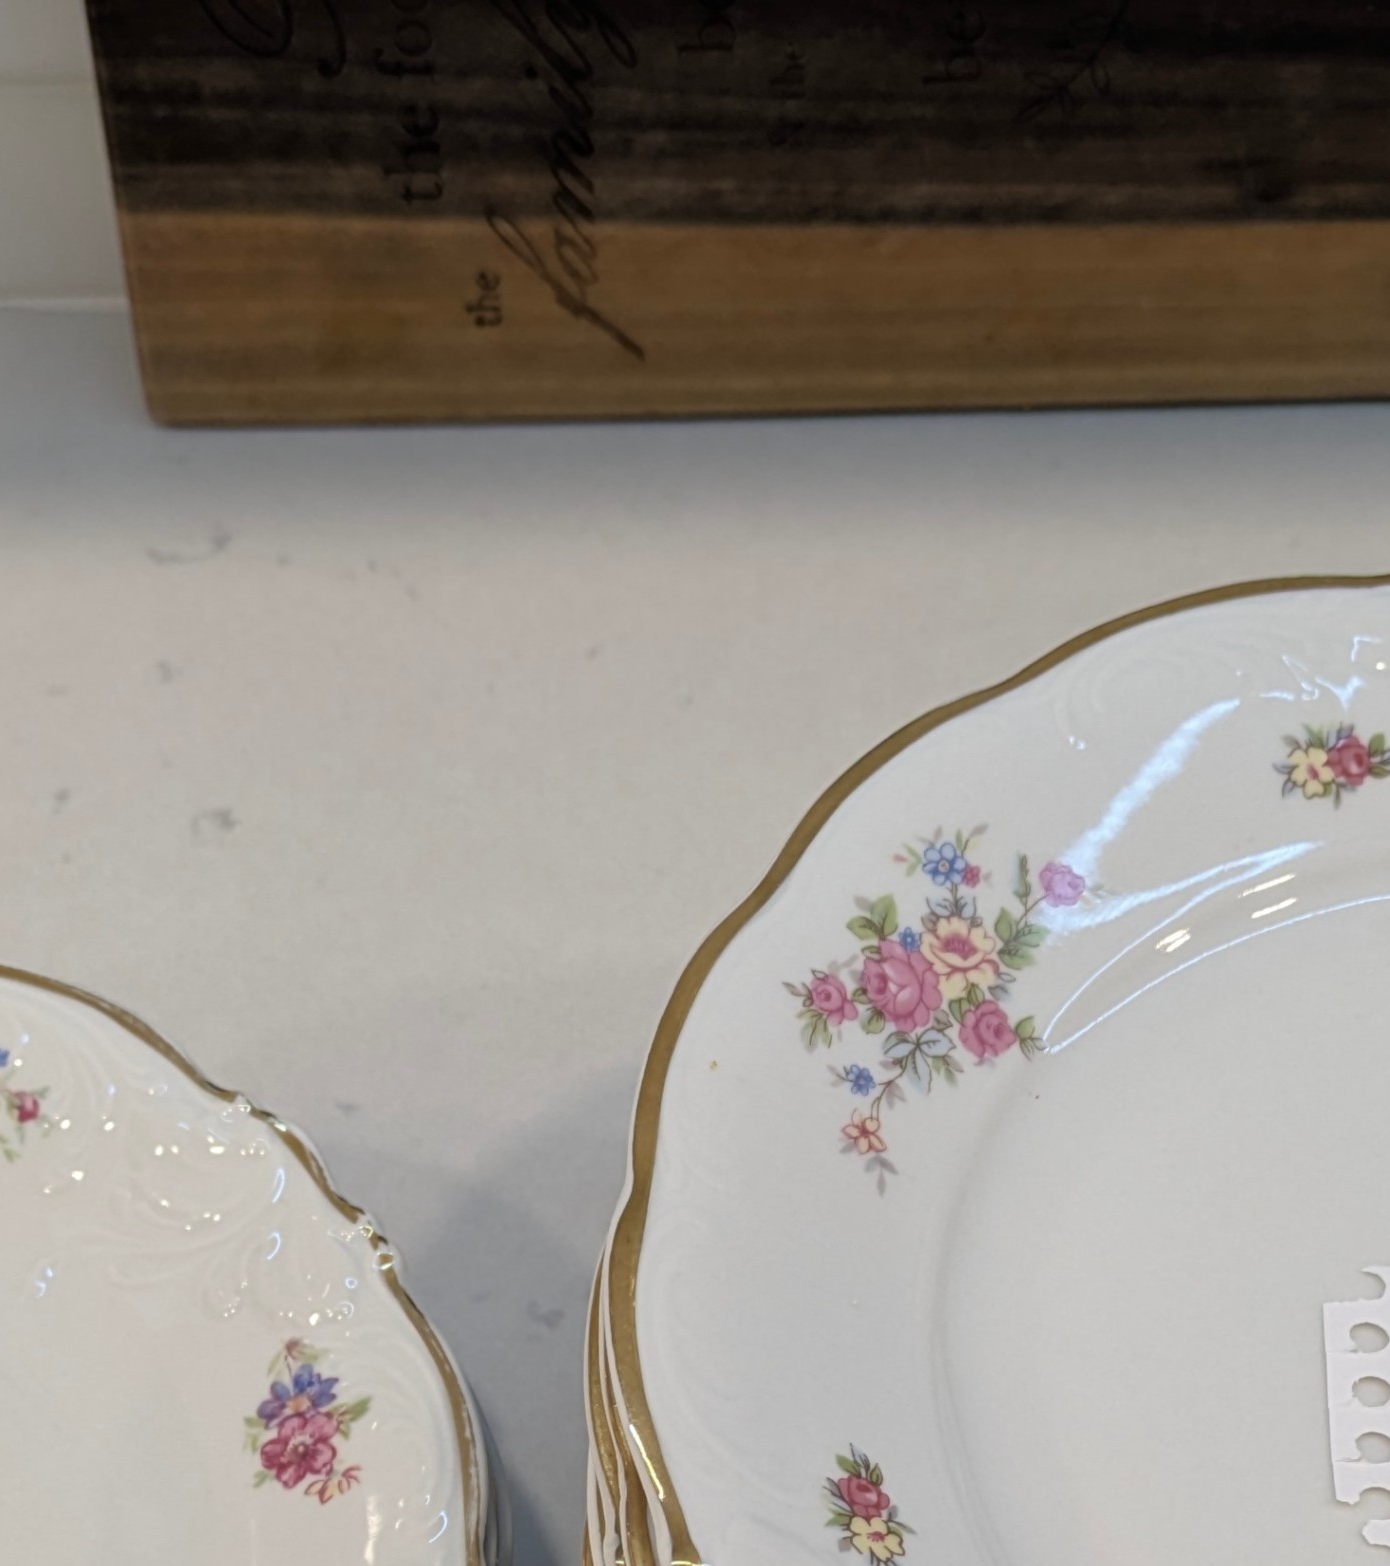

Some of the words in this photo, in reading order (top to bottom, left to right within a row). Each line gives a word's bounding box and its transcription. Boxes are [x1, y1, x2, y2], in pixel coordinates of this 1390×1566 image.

[382, 104, 444, 203] the
[484, 0, 645, 361] family
[466, 271, 503, 328] the
